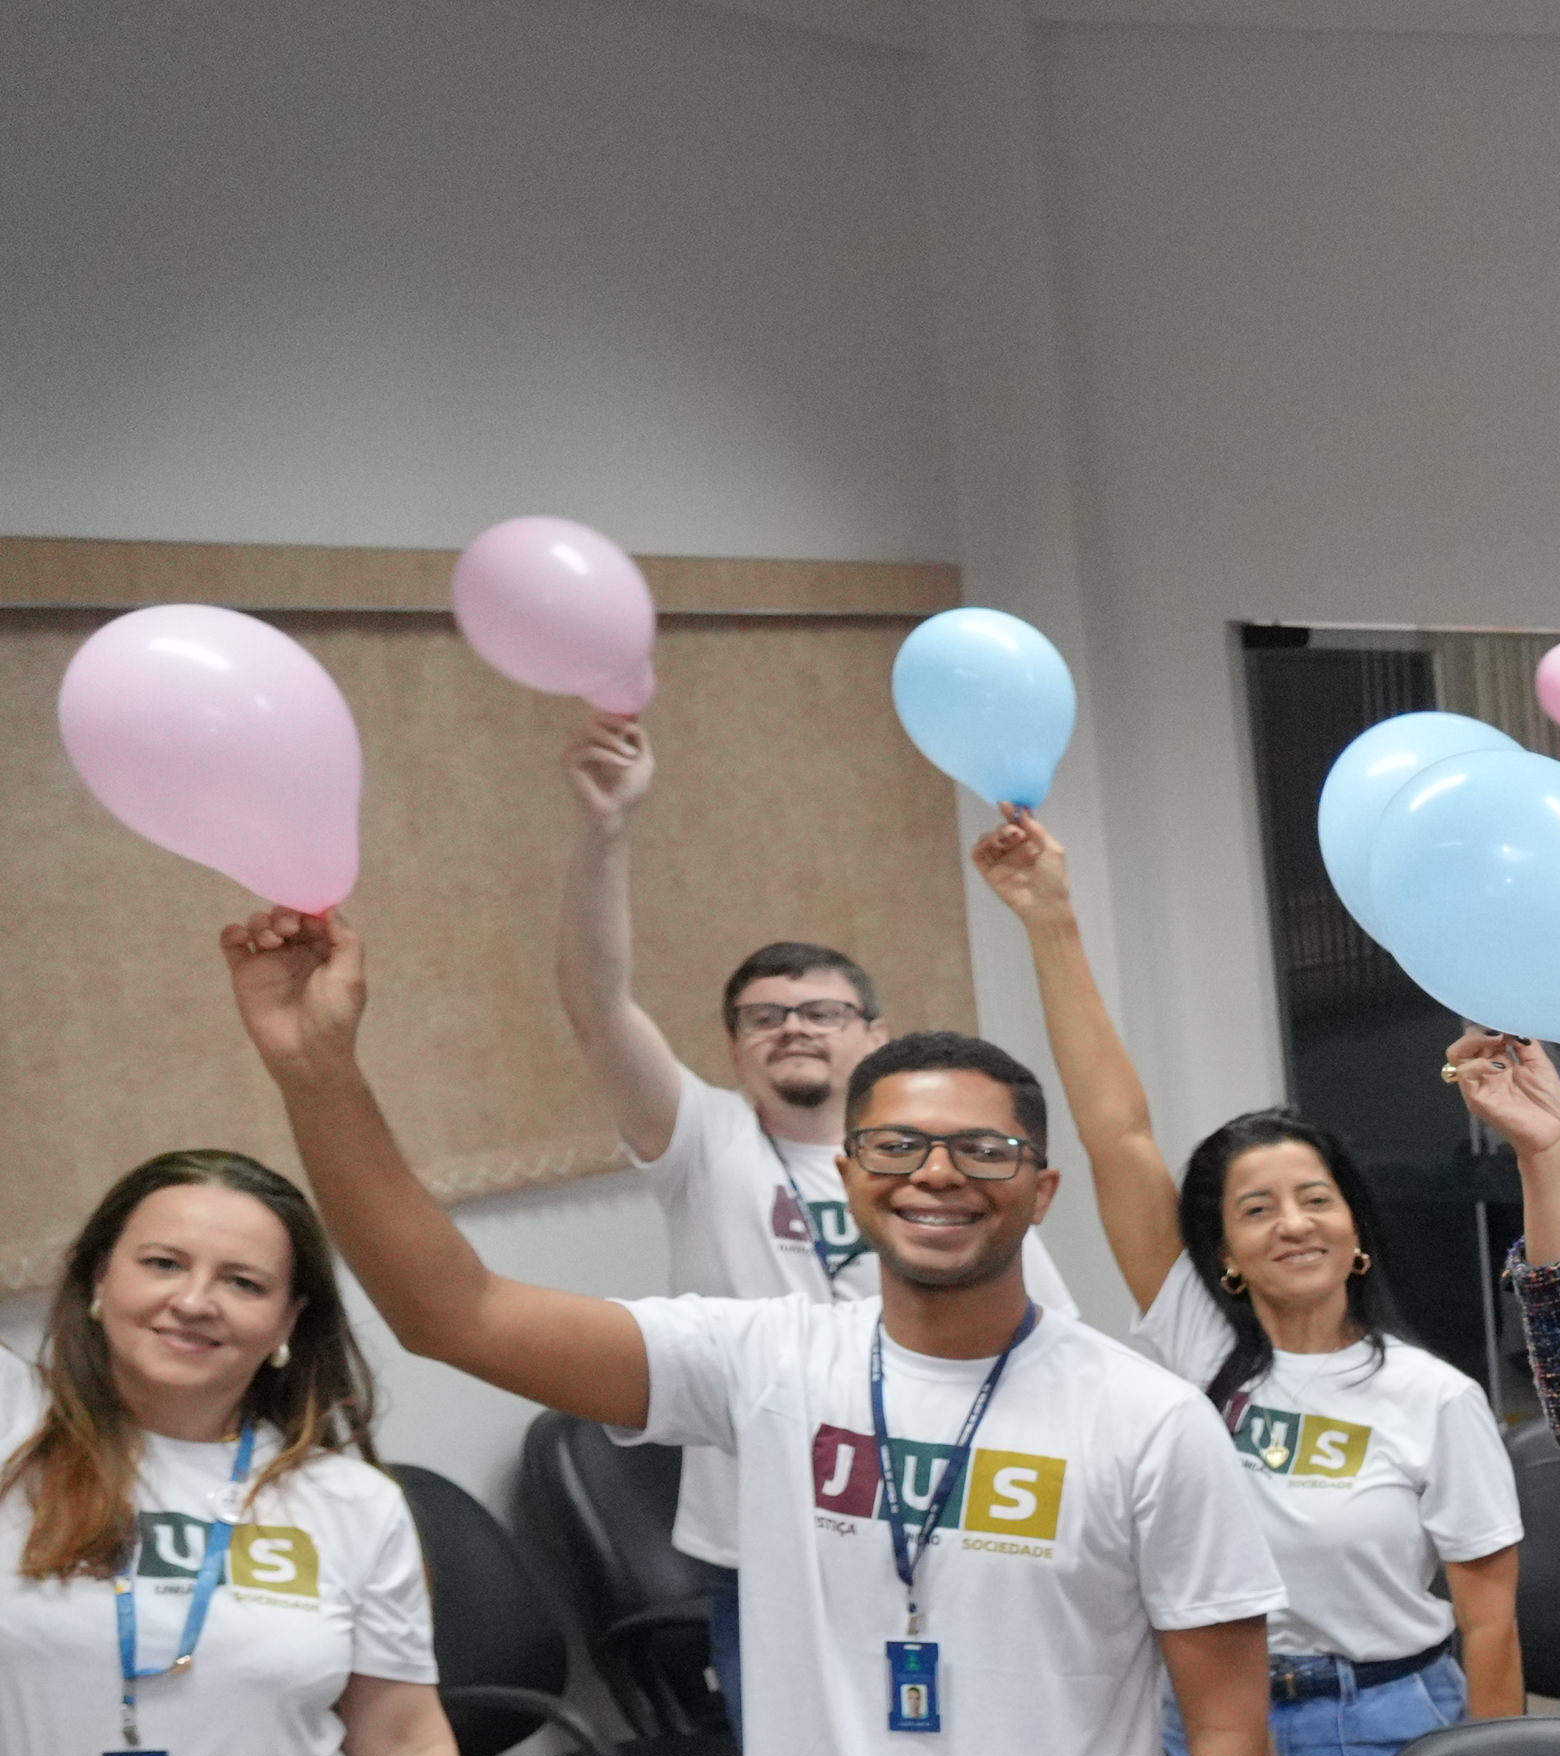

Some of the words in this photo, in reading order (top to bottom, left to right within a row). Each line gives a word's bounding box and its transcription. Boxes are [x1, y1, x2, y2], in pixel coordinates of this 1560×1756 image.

[821, 1443, 1039, 1521] JUS
[151, 1523, 298, 1583] US
[961, 1537, 1055, 1559] SOCIEDADE
